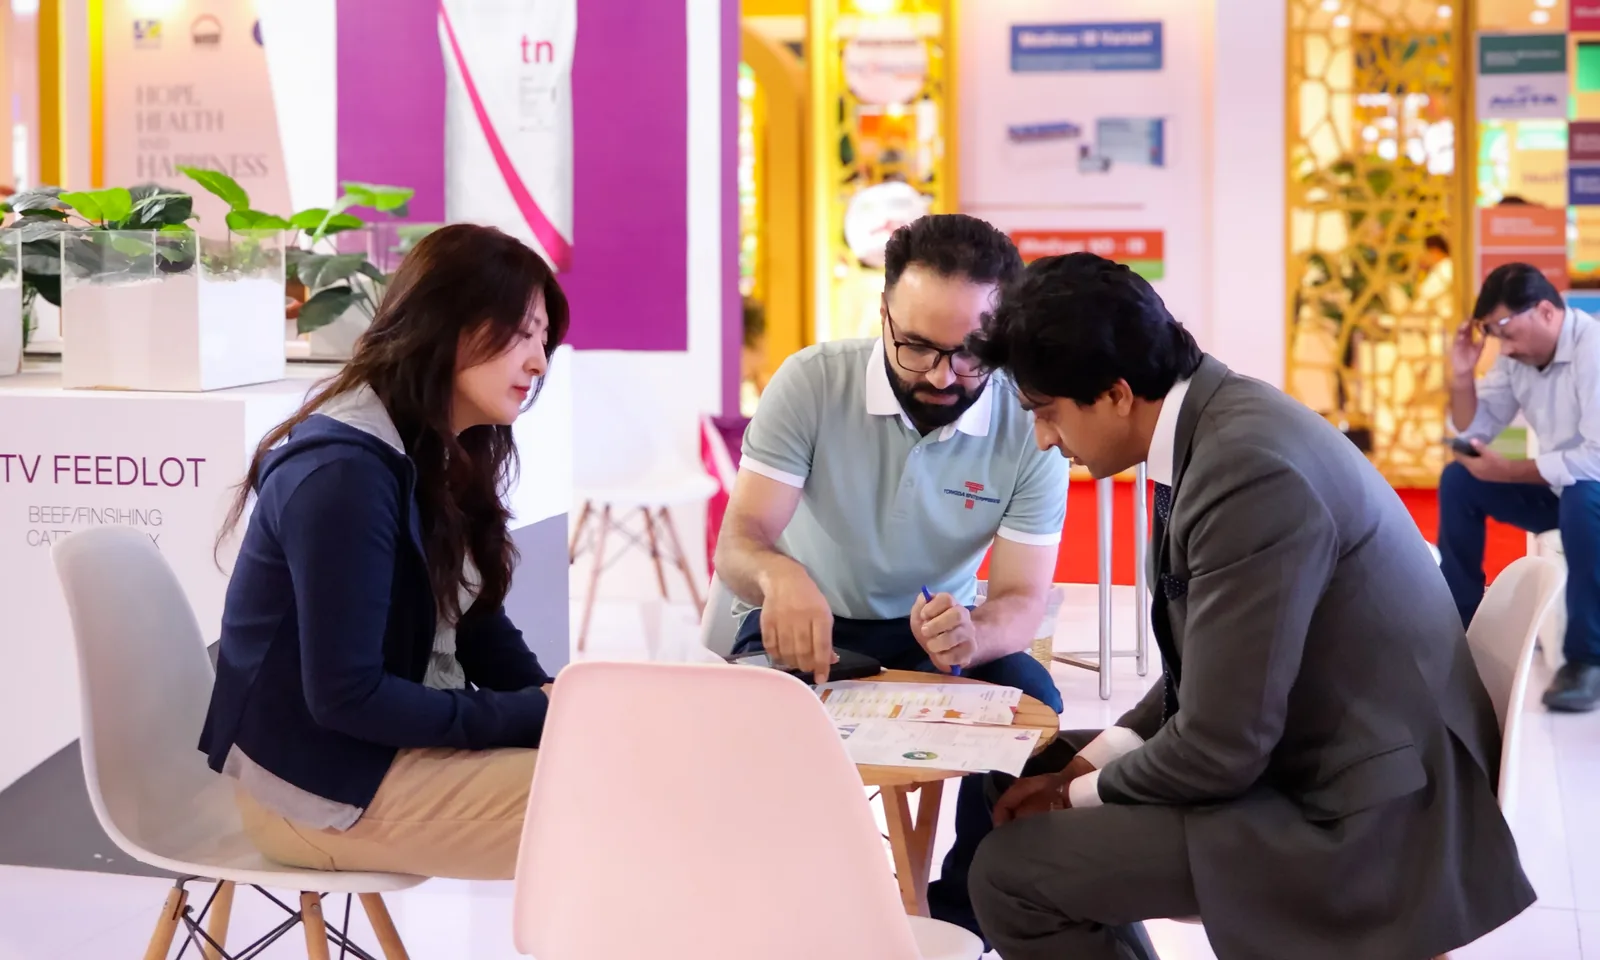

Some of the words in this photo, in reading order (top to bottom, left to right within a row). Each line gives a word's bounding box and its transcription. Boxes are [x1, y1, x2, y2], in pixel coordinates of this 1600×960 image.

[520, 34, 554, 64] tn
[136, 110, 224, 132] HEALTH
[54, 455, 206, 487] FEEDLOT
